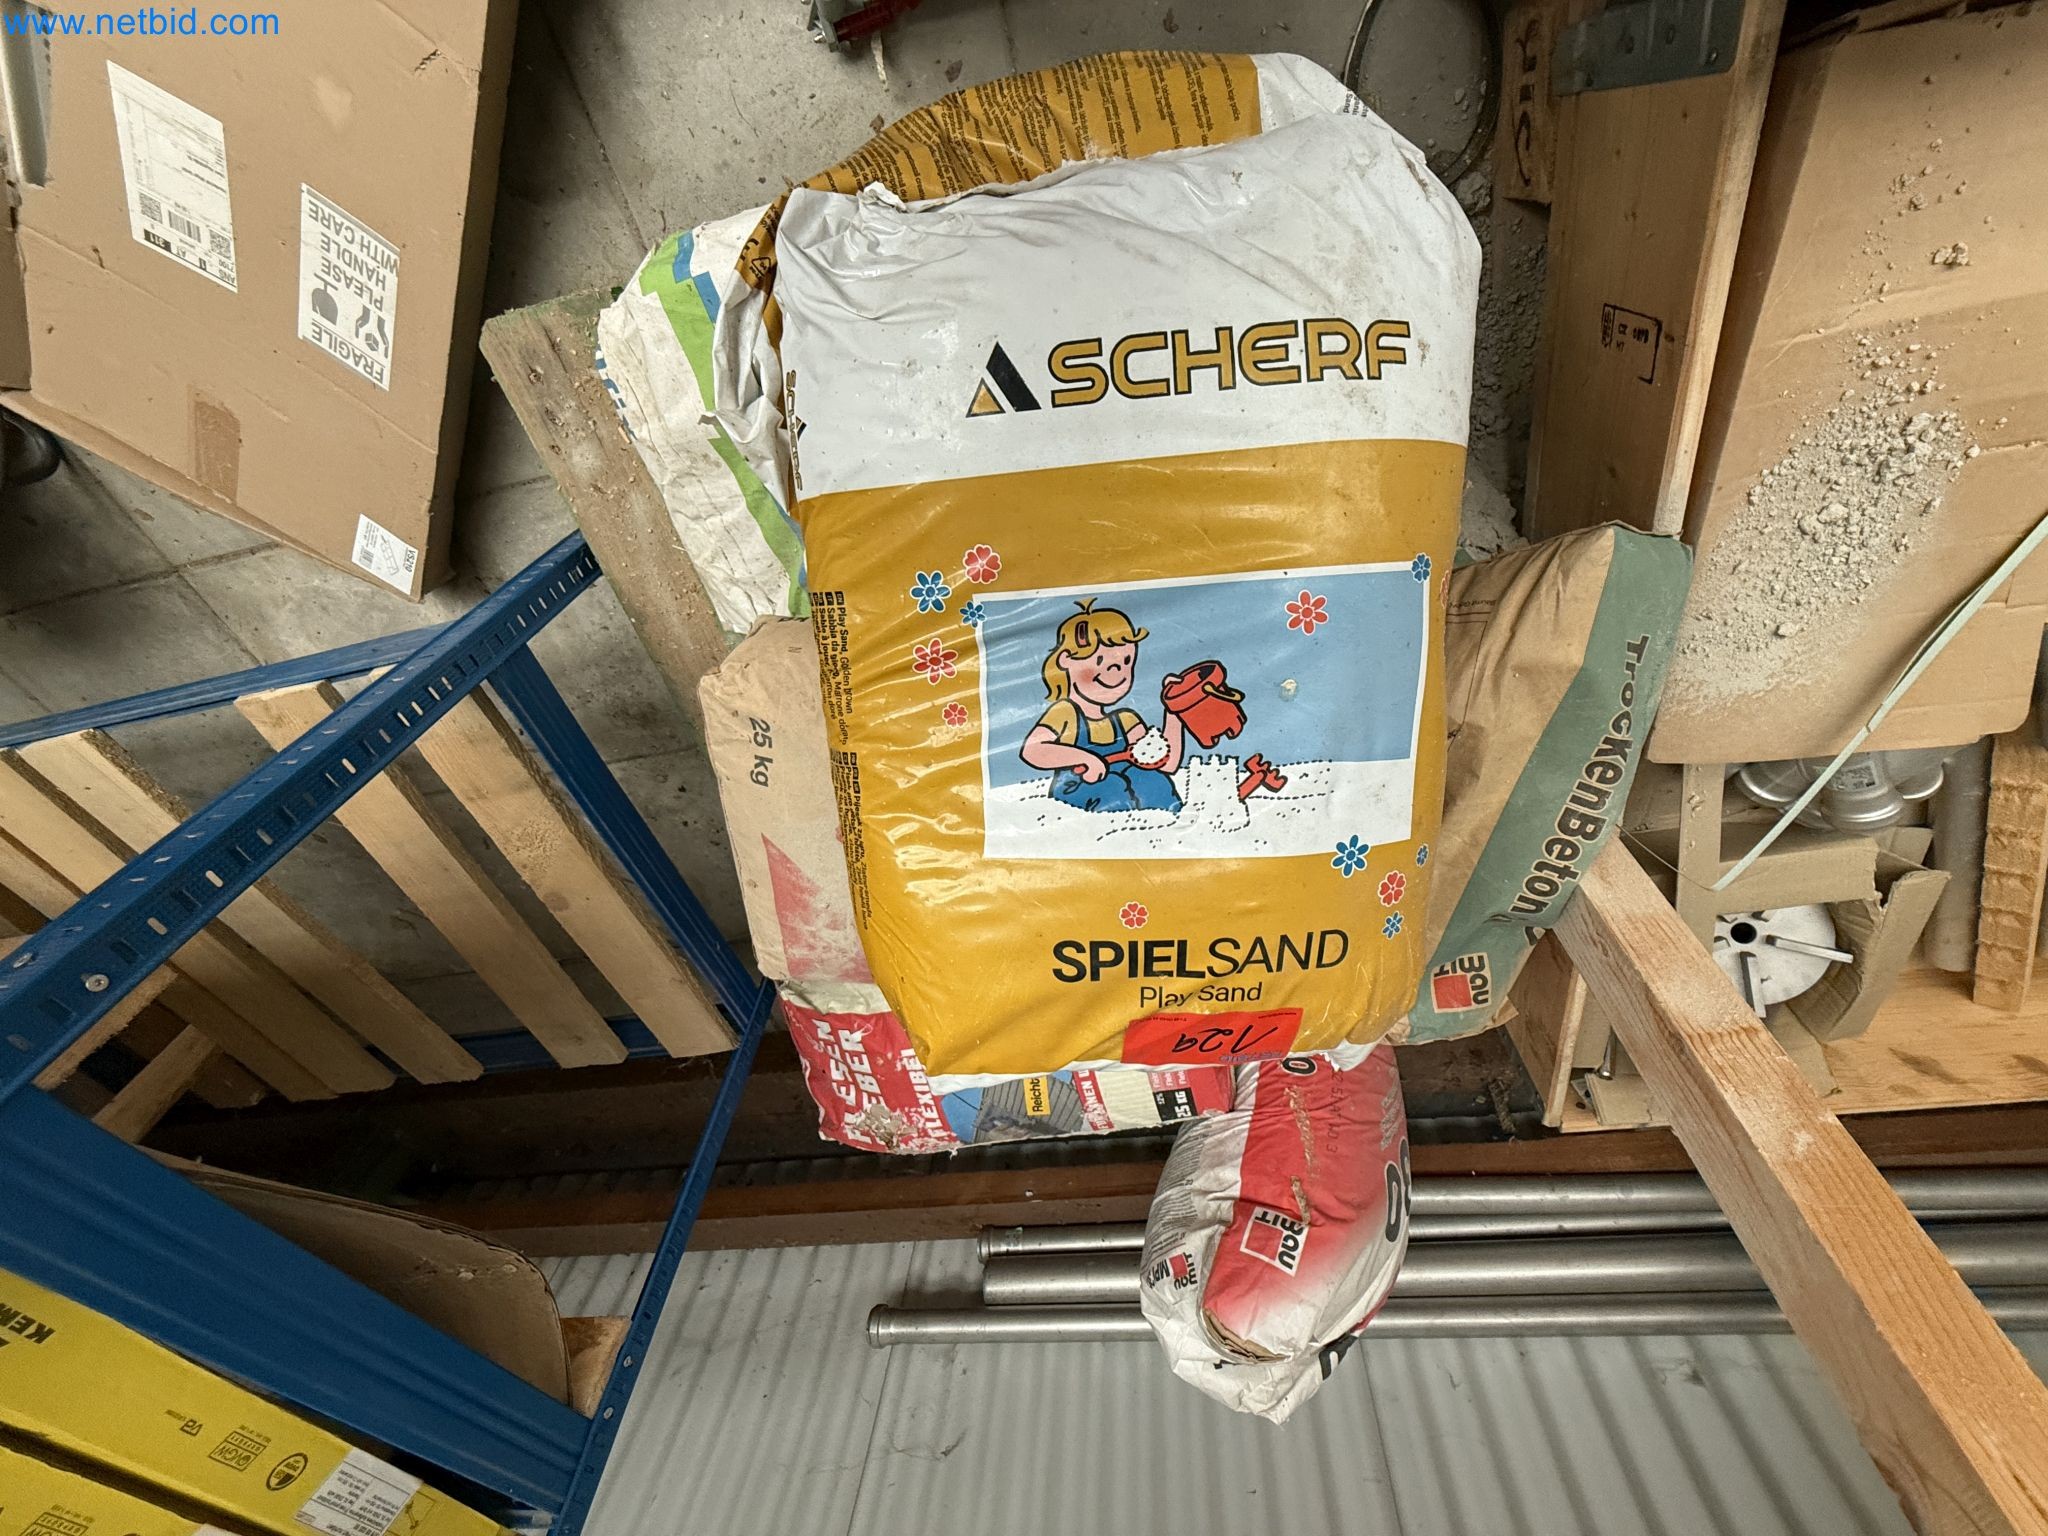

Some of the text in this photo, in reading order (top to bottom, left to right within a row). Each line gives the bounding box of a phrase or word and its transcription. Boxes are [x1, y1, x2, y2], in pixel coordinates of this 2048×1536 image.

[309, 200, 399, 275] WITH CARE
[321, 232, 386, 291] HANDLE
[322, 256, 384, 312] PLEASE
[312, 322, 384, 384] FRAGILE
[1048, 318, 1411, 408] SCHERF
[837, 607, 847, 628] Play
[840, 657, 852, 687] Golden
[749, 718, 773, 787] 25 kg
[1508, 635, 1649, 915] TrockenBeton
[1052, 929, 1349, 983] SPIELSAND
[1140, 982, 1262, 1008] Play Sand
[1175, 1091, 1192, 1117] 25 KG
